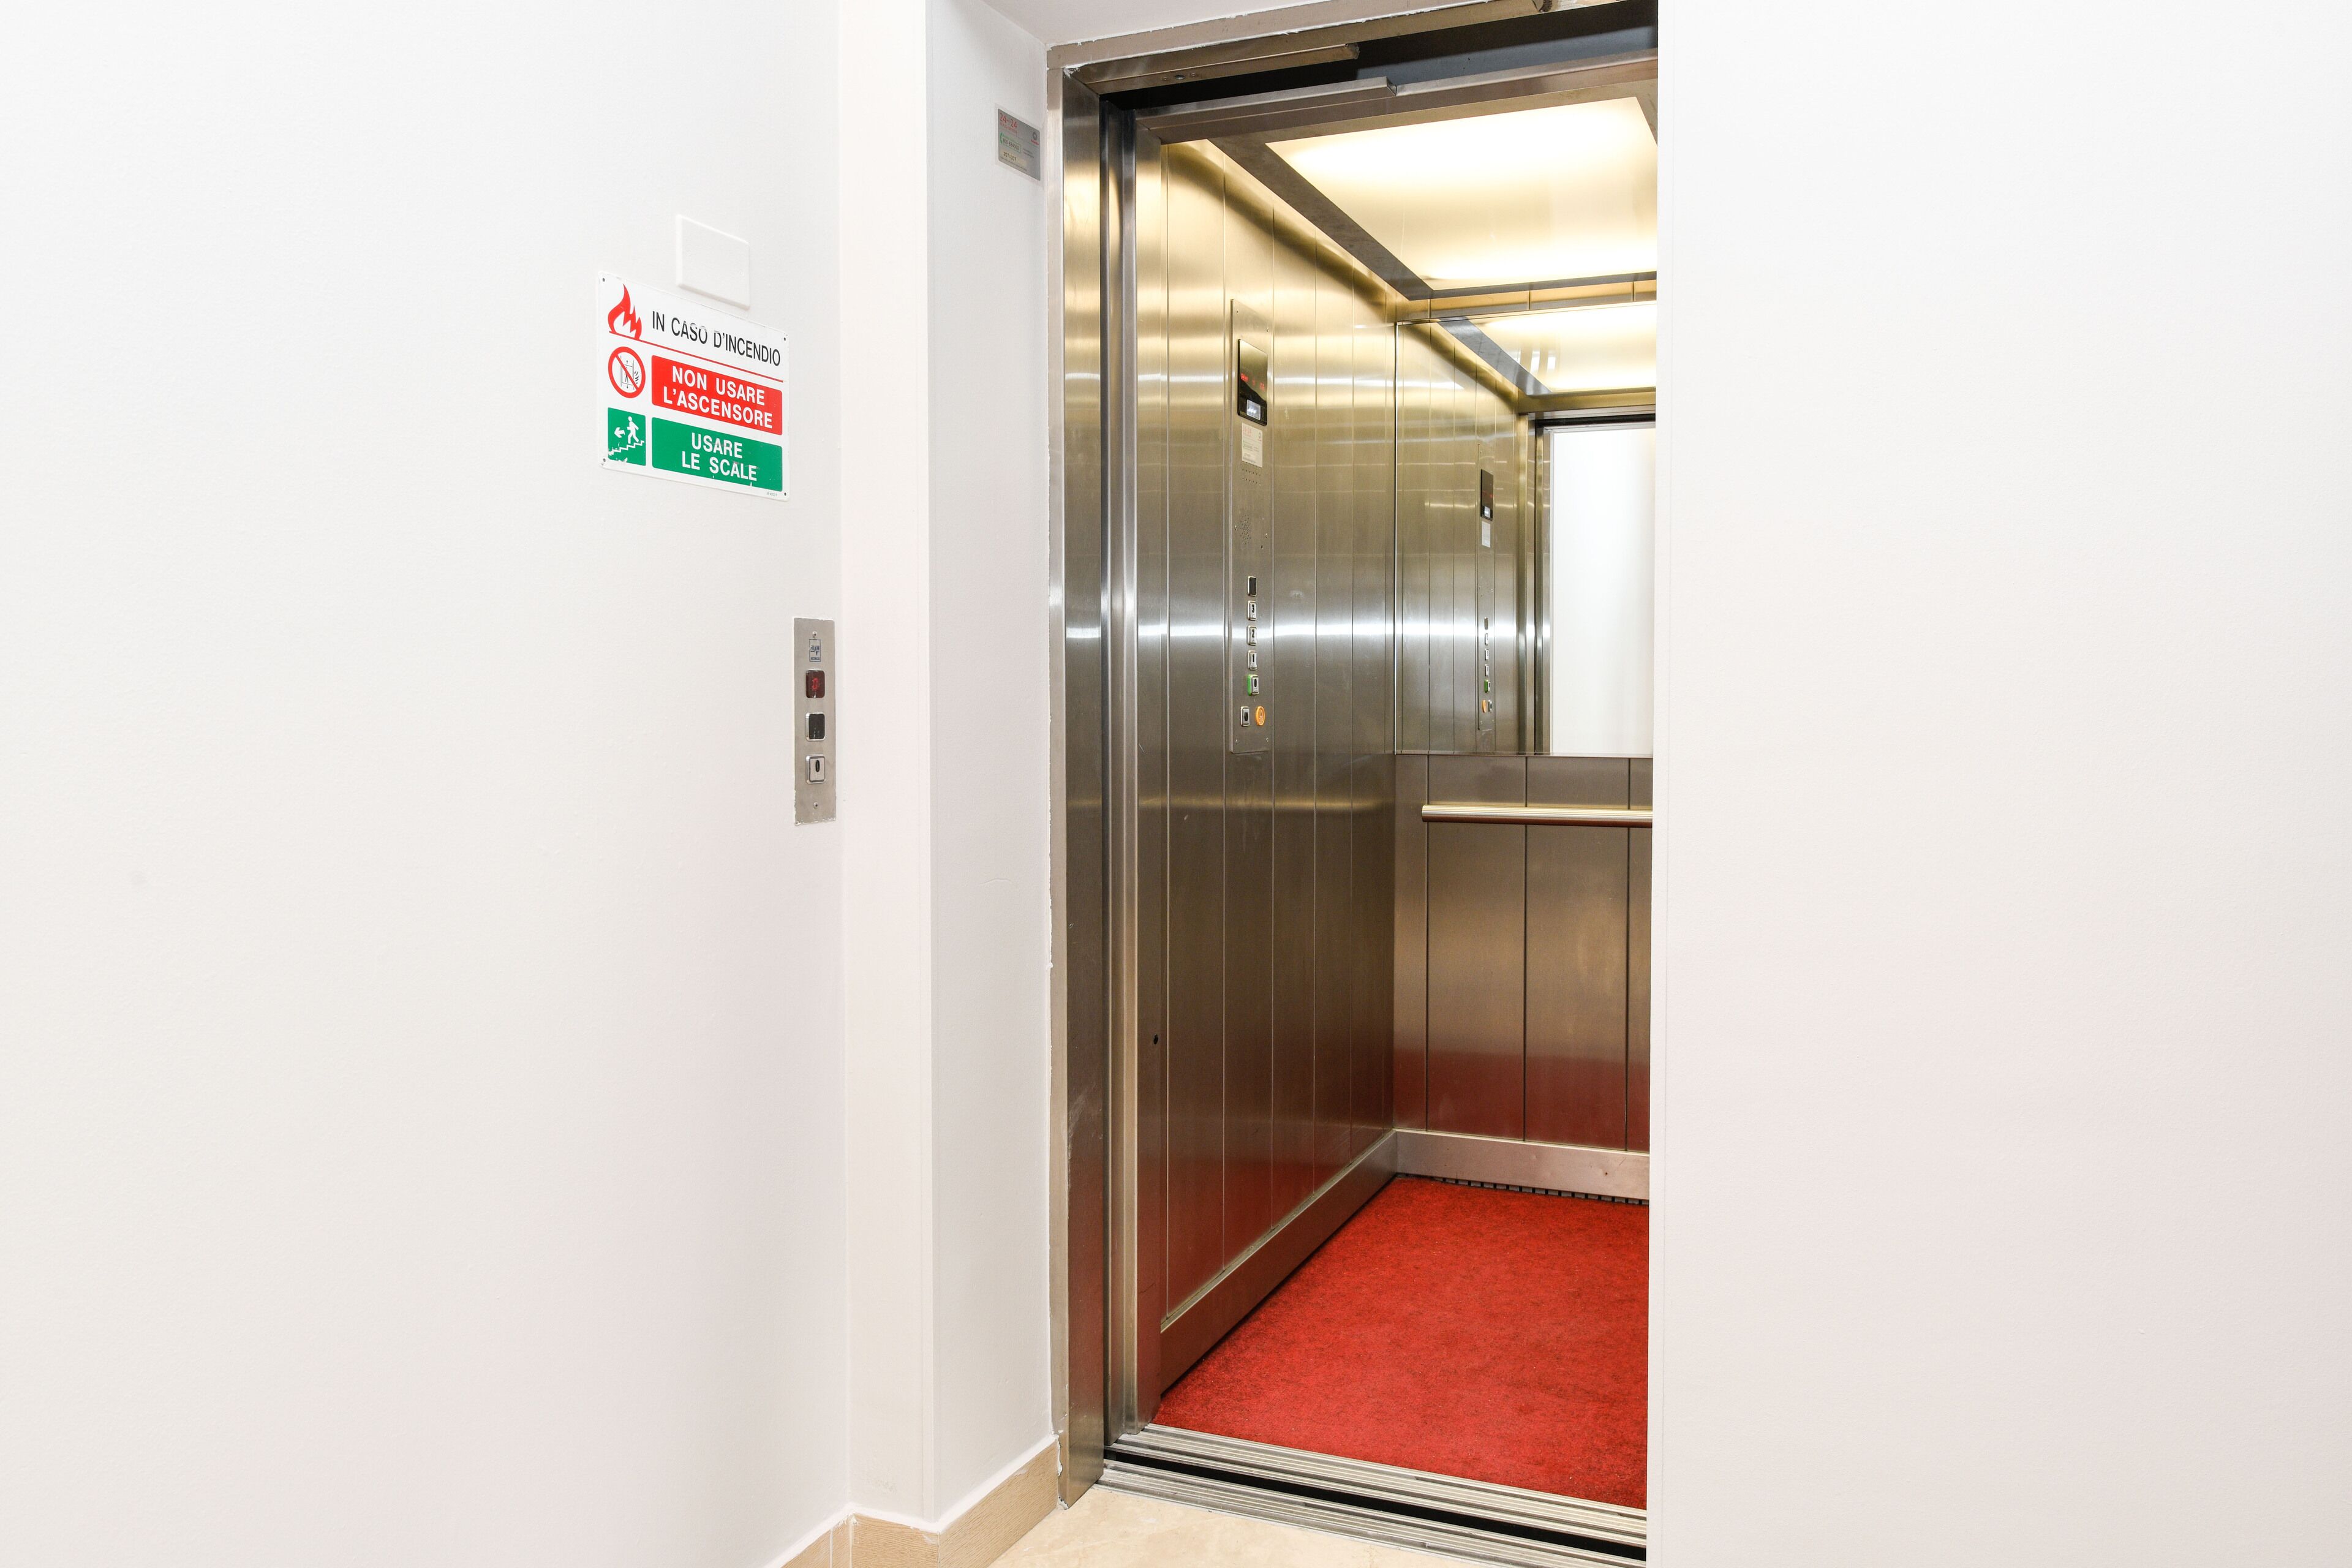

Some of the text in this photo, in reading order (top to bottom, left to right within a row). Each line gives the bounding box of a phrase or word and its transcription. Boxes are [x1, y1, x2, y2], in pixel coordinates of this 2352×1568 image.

[652, 311, 781, 366] IN CASO D'INCENDIO
[672, 366, 766, 406] NON USARE
[663, 386, 773, 429] L'ASCENSORE
[692, 432, 743, 459] USARE
[682, 451, 758, 481] LE SCALE
